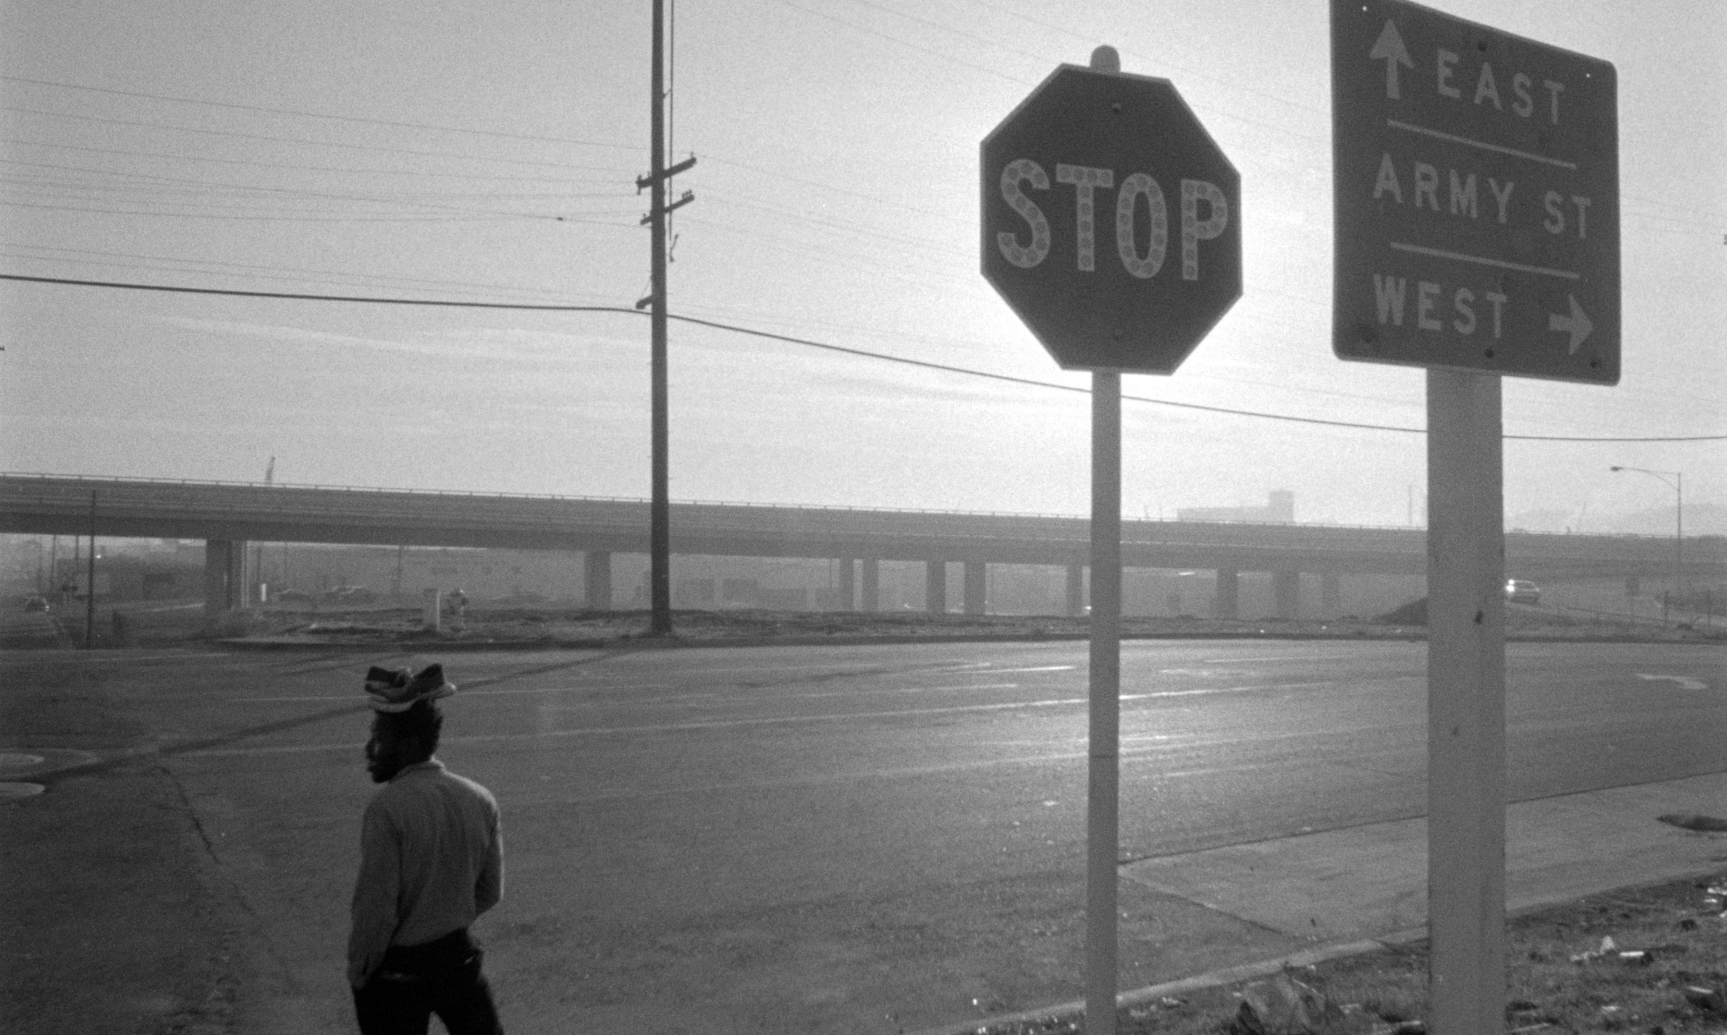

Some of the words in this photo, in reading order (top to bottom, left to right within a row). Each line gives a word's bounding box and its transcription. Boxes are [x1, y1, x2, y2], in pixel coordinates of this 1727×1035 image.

[1437, 49, 1565, 125] EAST
[997, 158, 1228, 280] STOP
[1373, 153, 1514, 224] ARMY
[1543, 190, 1591, 239] ST
[1373, 274, 1507, 339] WEST
